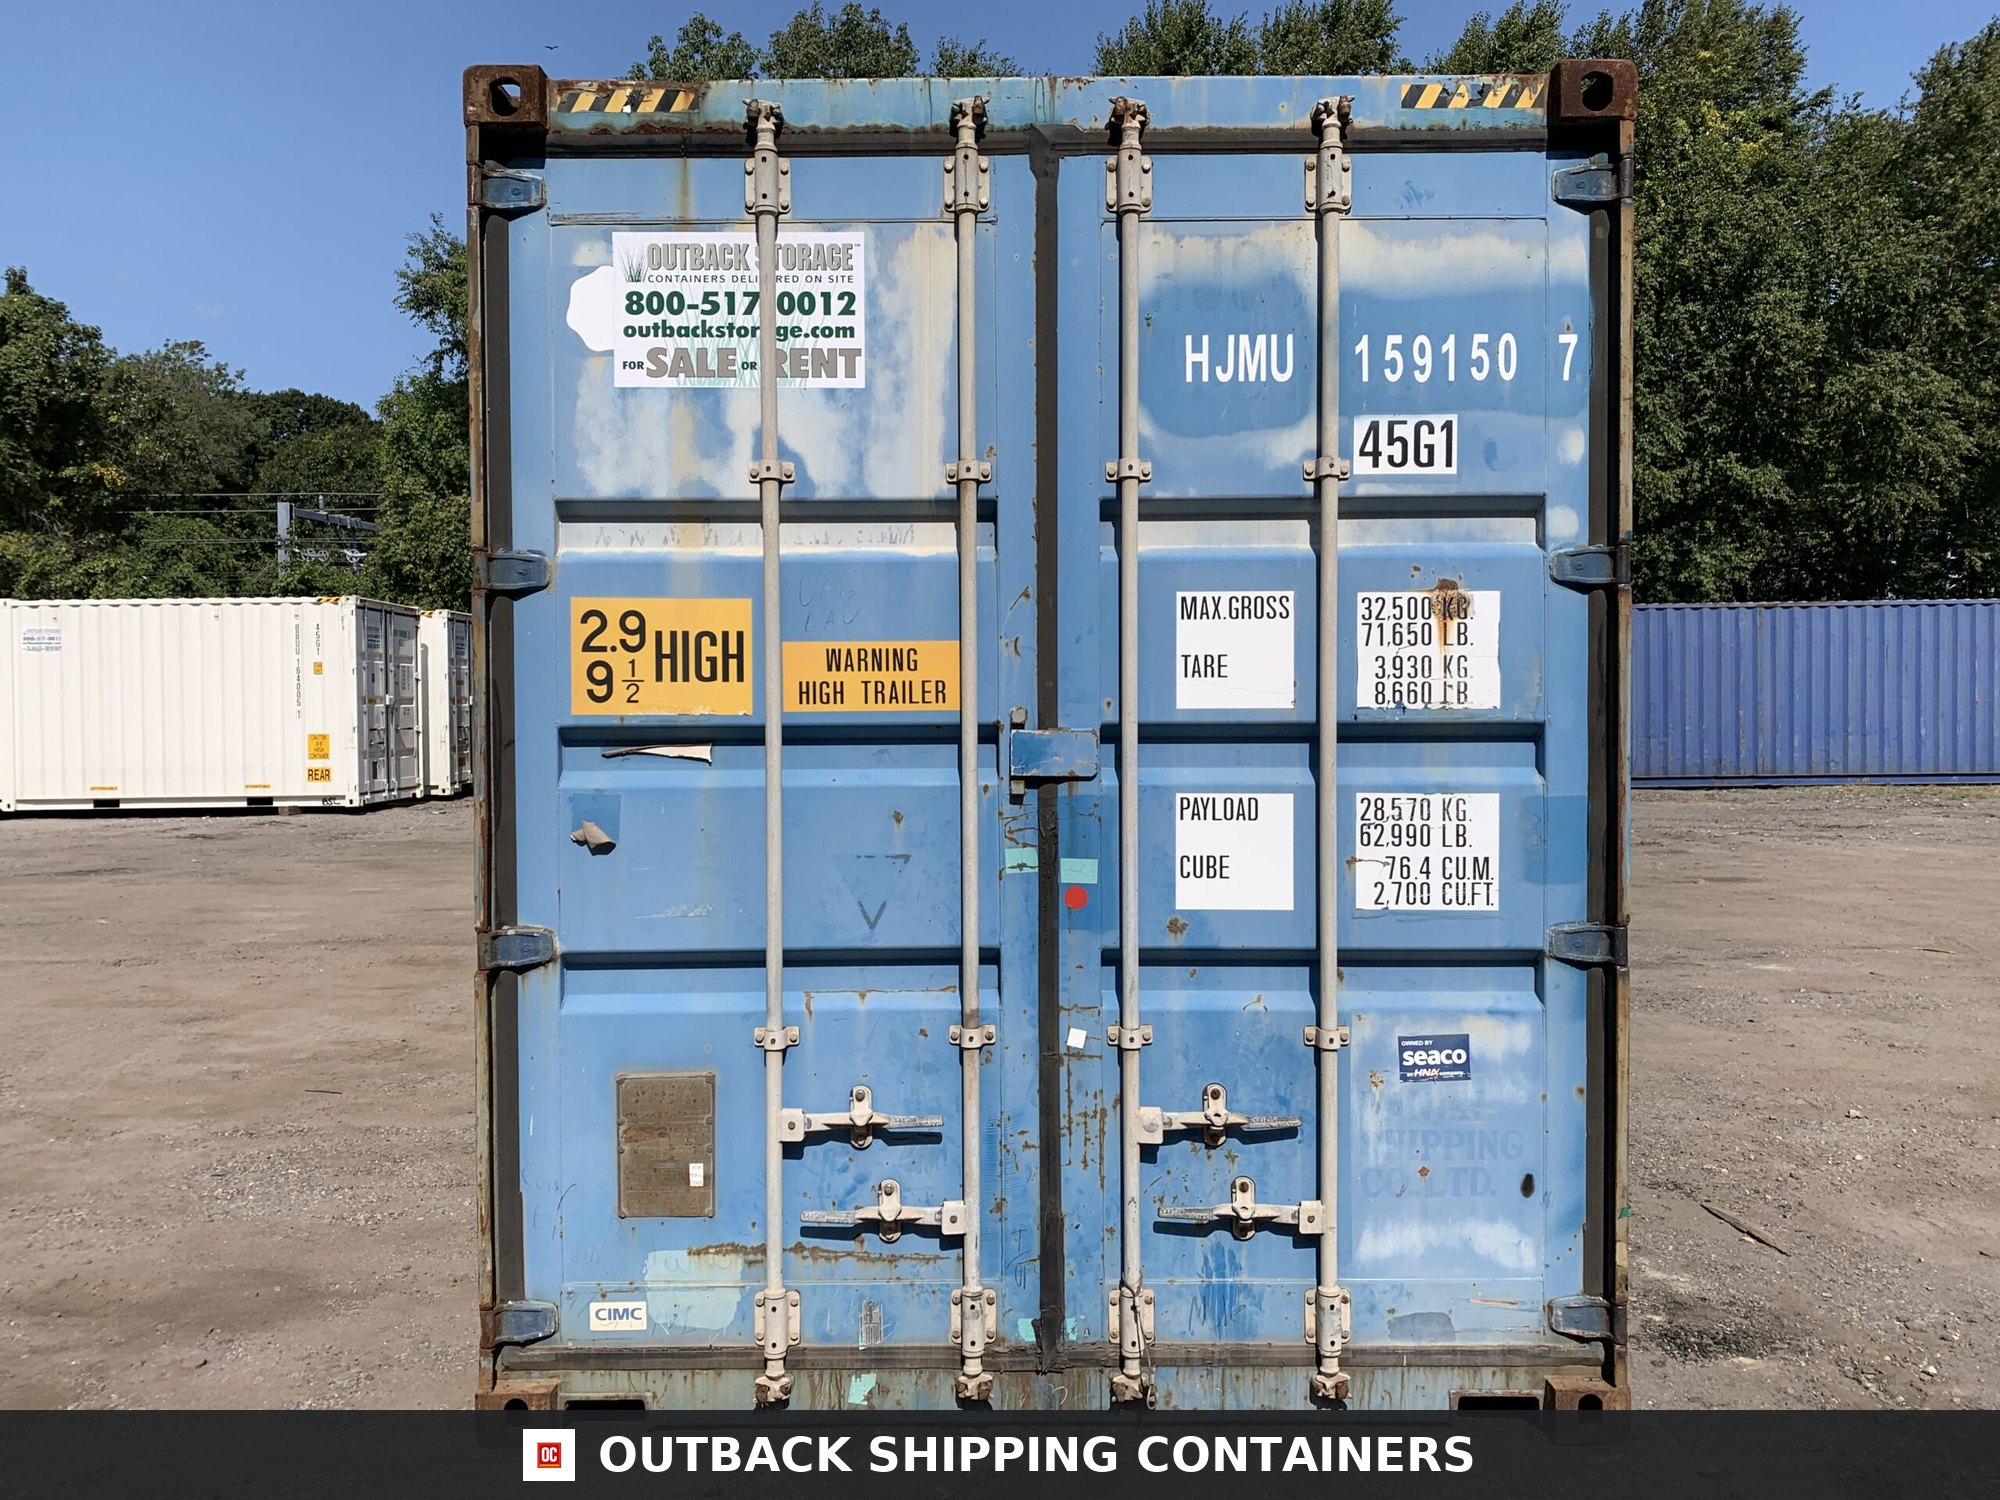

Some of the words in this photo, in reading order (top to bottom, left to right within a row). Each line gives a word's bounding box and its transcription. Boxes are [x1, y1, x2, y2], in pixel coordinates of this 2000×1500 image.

[647, 243, 750, 271] OUTBACK
[755, 243, 854, 271] TORAGE
[648, 275, 726, 283] CONTAINERS
[731, 275, 800, 283] DELIRED
[805, 275, 822, 283] ON
[828, 275, 854, 283] SITE
[624, 291, 856, 316] 800-5170012
[623, 319, 855, 342] outbackstorge.com
[622, 361, 644, 370] FOR
[646, 347, 737, 379] SALE
[741, 361, 758, 370] OR
[1185, 333, 1294, 382] HJMU
[1355, 333, 1518, 383] 159150
[1558, 333, 1579, 382] 7
[1358, 420, 1454, 468] 45G1
[1361, 596, 1432, 621] 32,500
[580, 609, 646, 653] 2.9
[1361, 622, 1432, 647] 71,650
[1444, 622, 1474, 647] LB.
[655, 630, 744, 682] HIGH
[826, 648, 919, 672] WARNING
[1181, 654, 1228, 679] TARE
[1375, 655, 1432, 680] 3,930
[586, 660, 614, 703] 9
[799, 681, 845, 705] HIGH
[860, 680, 946, 705] TRAILER
[1375, 681, 1432, 705] 8,660
[308, 769, 330, 780] REAR
[1180, 797, 1259, 821] PAYLOAD
[1360, 797, 1431, 822] 28,570
[1442, 797, 1472, 822] KG.
[1360, 823, 1431, 848] 62,990
[1442, 823, 1472, 848] LB.
[1180, 855, 1230, 879] CUBE
[1385, 856, 1431, 880] 76.4
[1374, 882, 1431, 905] 2,700
[1402, 1048, 1467, 1066] seaco
[595, 1307, 643, 1321] CIMC
